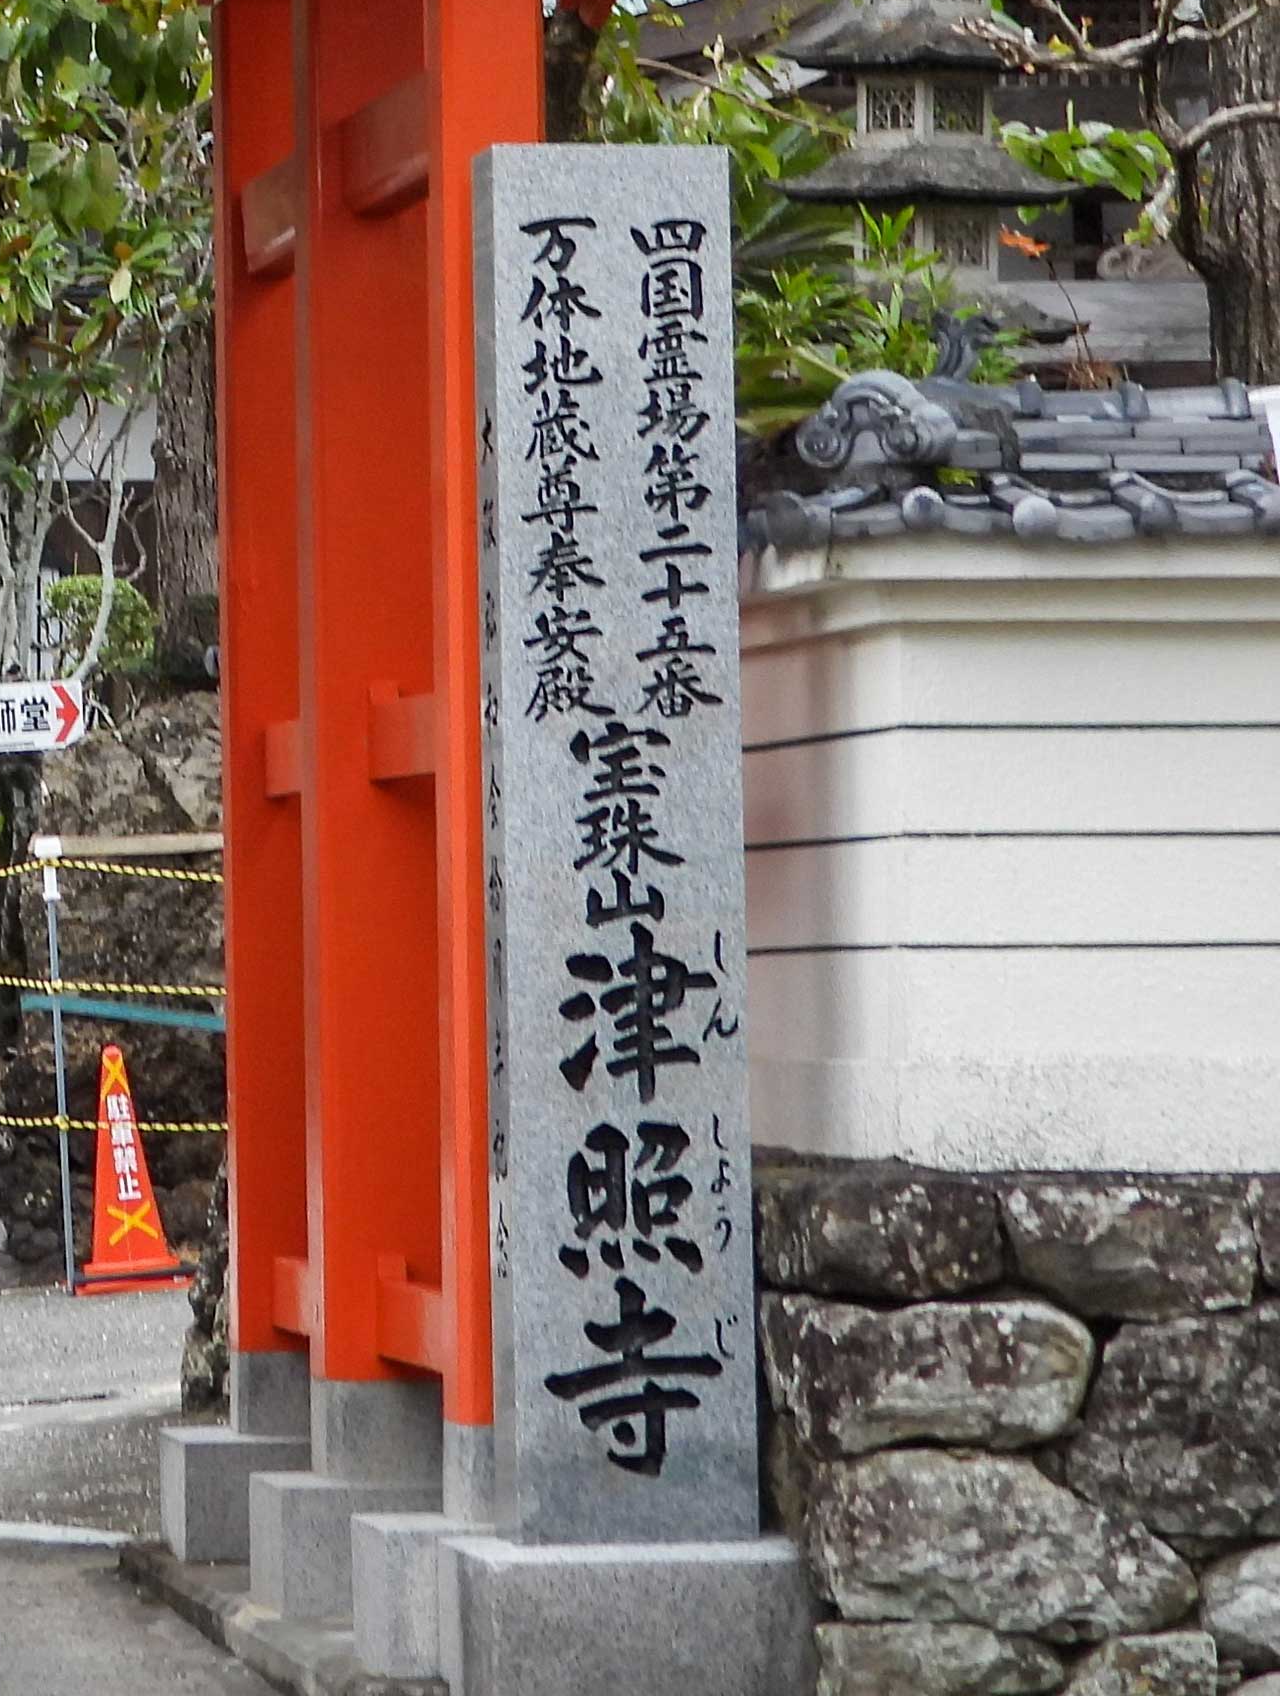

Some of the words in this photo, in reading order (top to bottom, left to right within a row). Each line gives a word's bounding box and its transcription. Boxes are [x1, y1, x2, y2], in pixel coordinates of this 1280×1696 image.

[520, 216, 616, 721] 万体地蔵尊奉安殿
[629, 219, 724, 719] 四国霊場第二十五番
[544, 721, 723, 1478] 宝珠山津照寺
